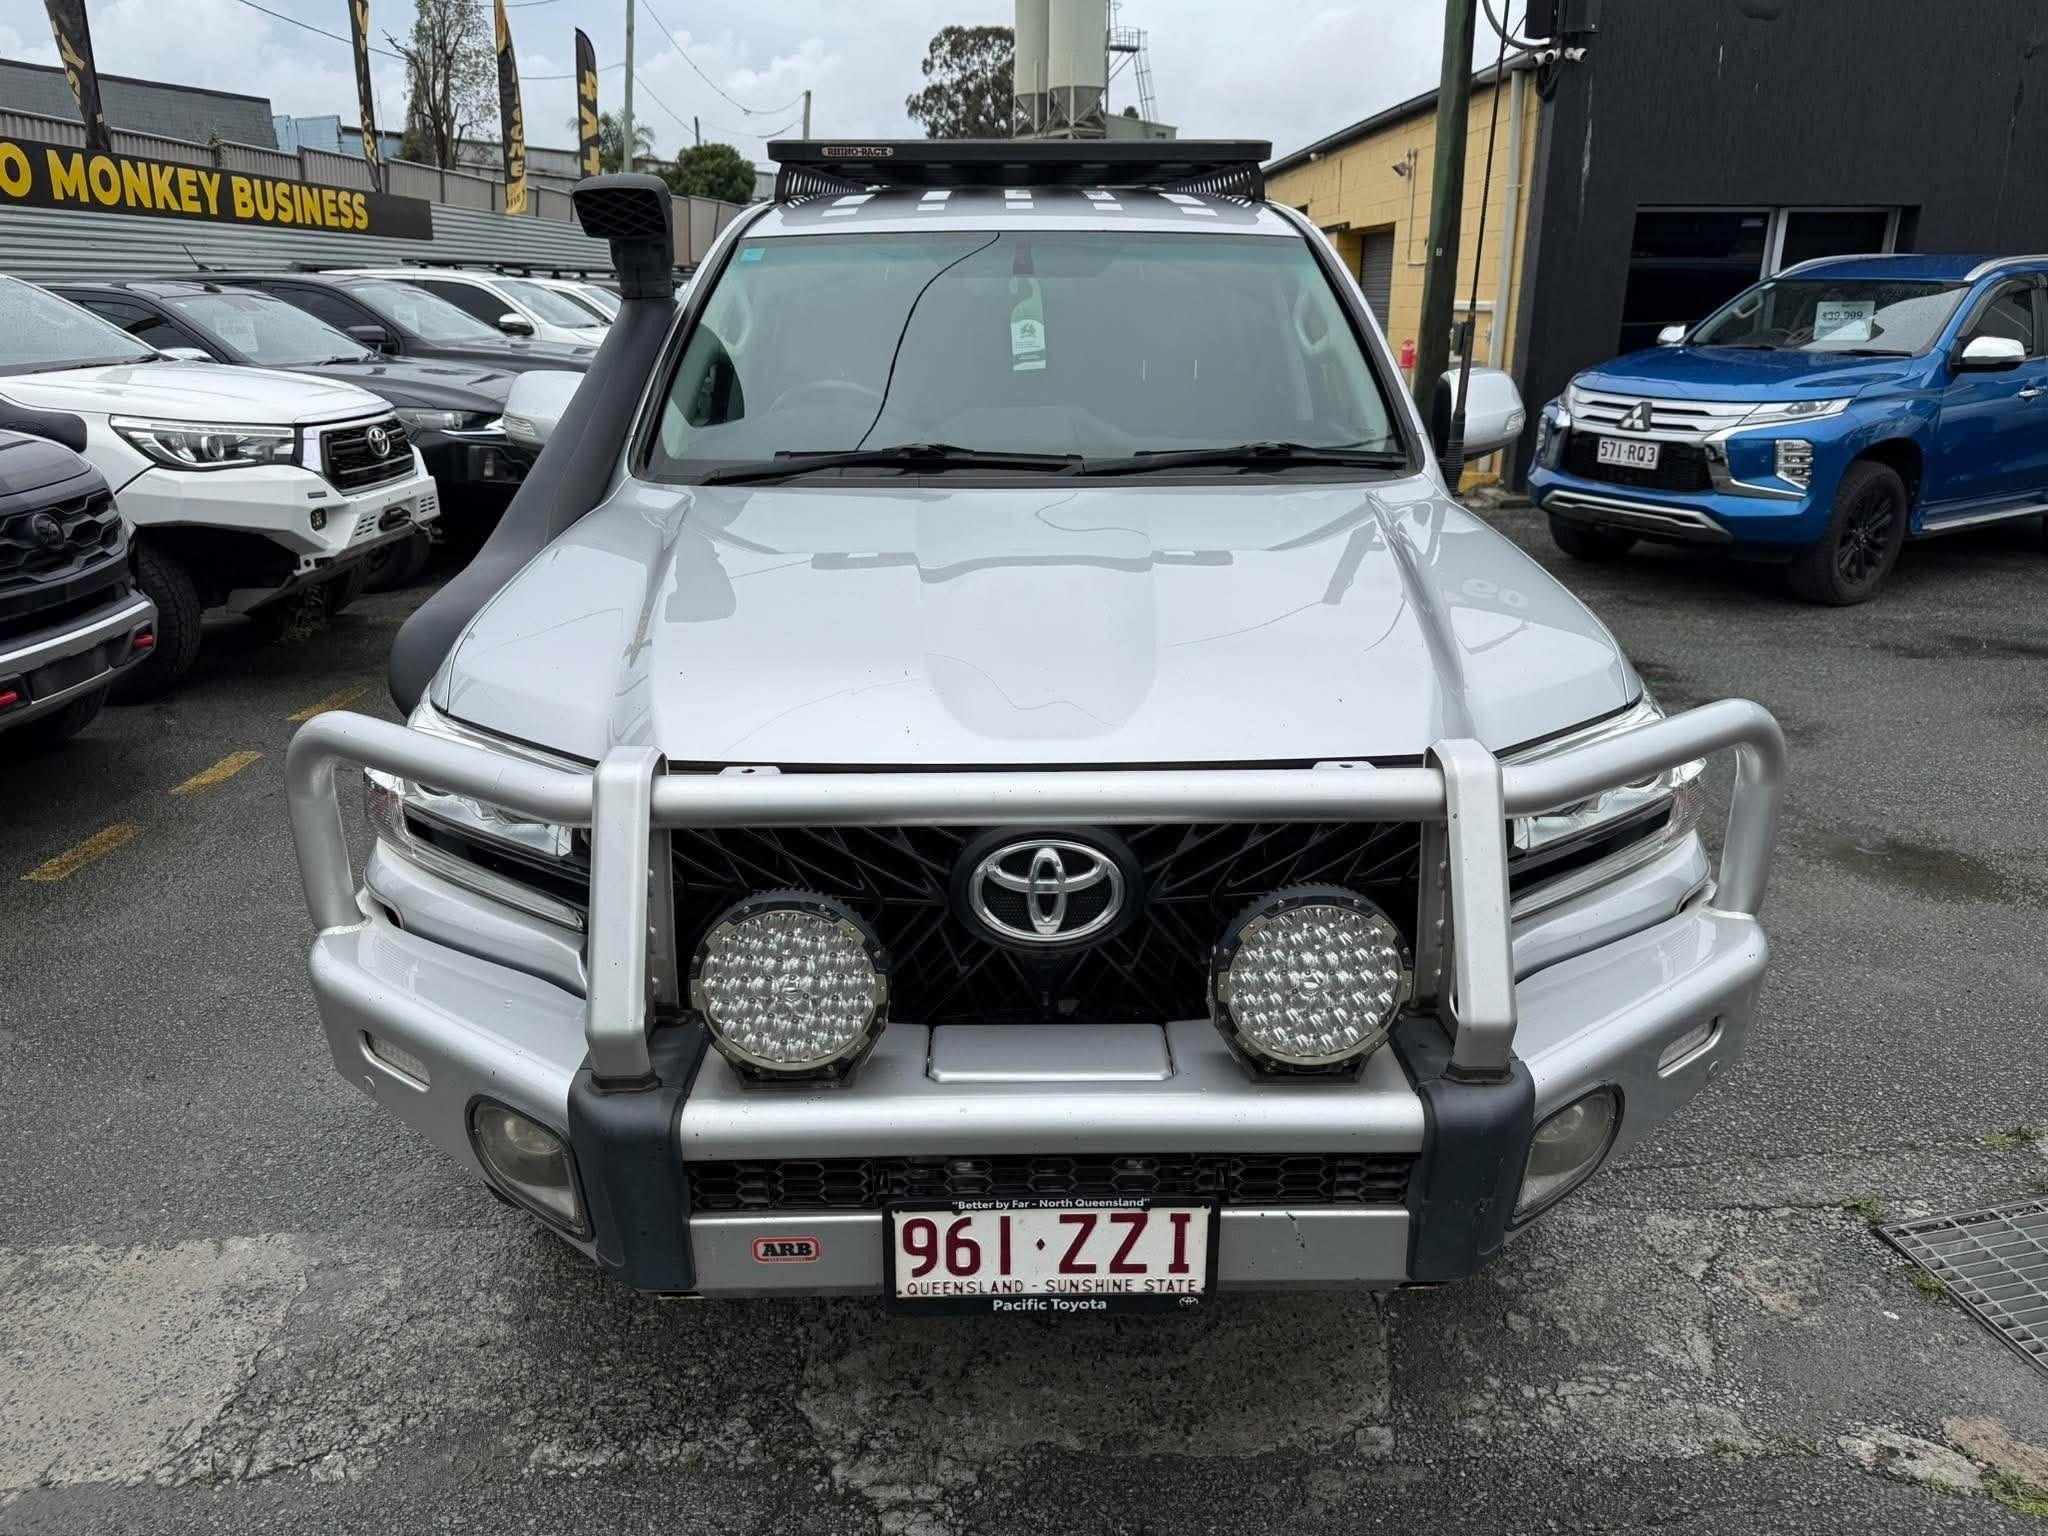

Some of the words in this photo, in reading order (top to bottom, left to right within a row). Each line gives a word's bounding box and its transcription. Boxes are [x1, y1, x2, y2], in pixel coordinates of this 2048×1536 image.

[46, 149, 221, 216] MONKEY
[231, 176, 369, 230] BUSINESS
[996, 1201, 1009, 1210] by
[1012, 1200, 1029, 1208] Far
[1040, 1199, 1073, 1208] North
[762, 1242, 813, 1257] ARB
[907, 1280, 1024, 1295] QUEENSLAND
[1045, 1279, 1135, 1292] SUNSHINE
[1144, 1279, 1197, 1292] STATE
[992, 1299, 1048, 1311] Pacific
[1051, 1298, 1107, 1312] Toyota
